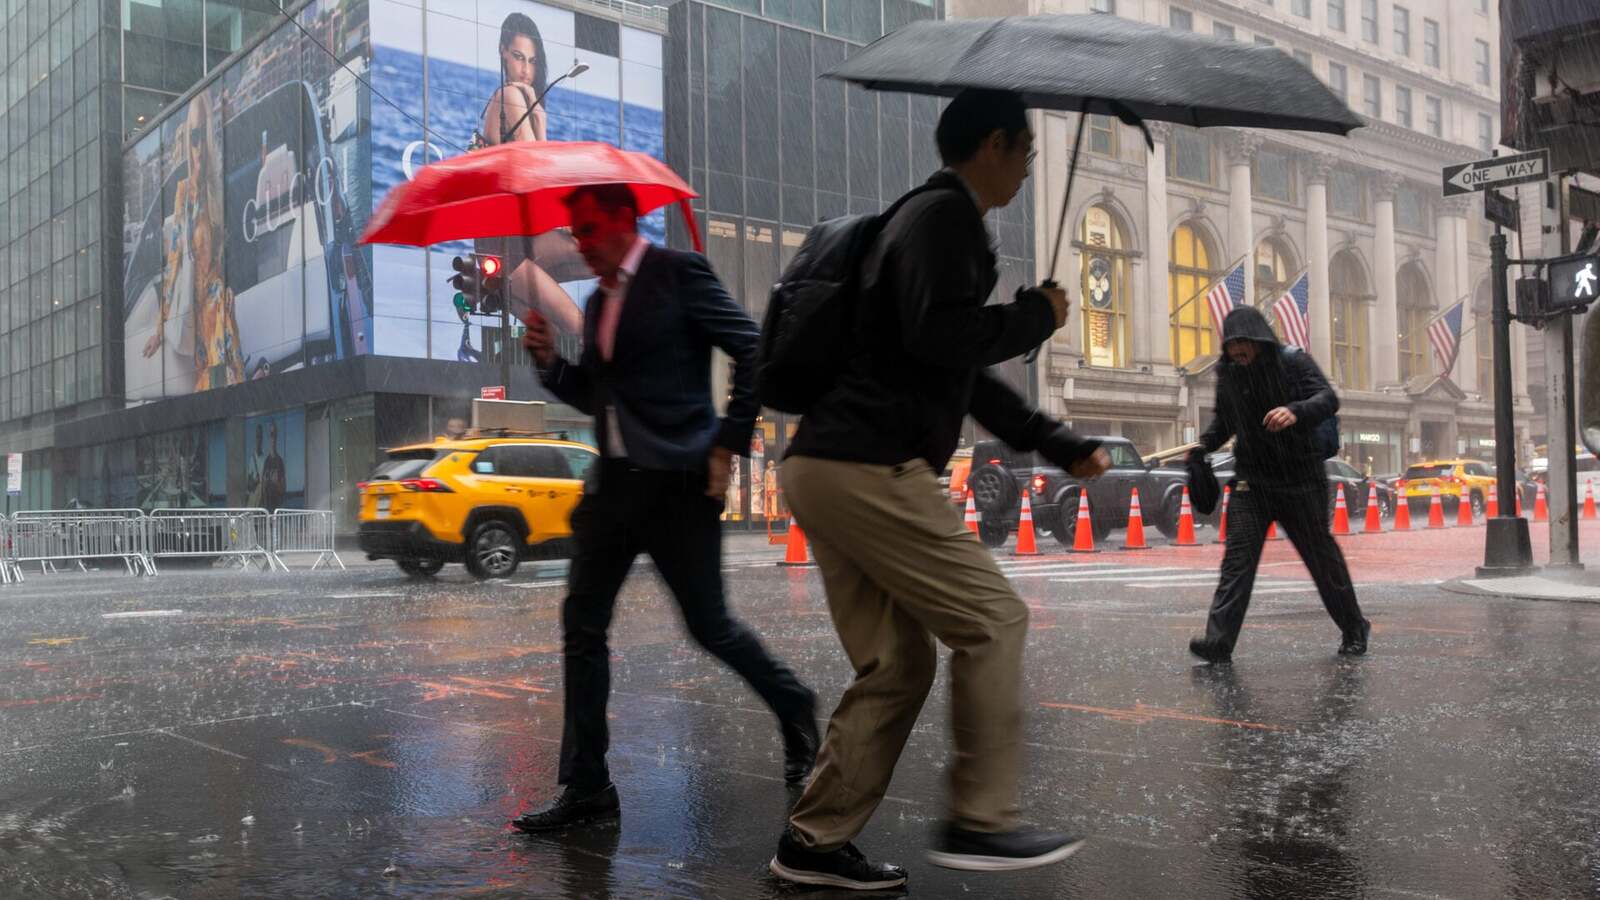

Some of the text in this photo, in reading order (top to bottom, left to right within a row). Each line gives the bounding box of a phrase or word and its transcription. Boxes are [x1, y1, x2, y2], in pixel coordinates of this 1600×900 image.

[243, 144, 348, 243] GUCCI
[1462, 161, 1537, 184] ONE WAY
